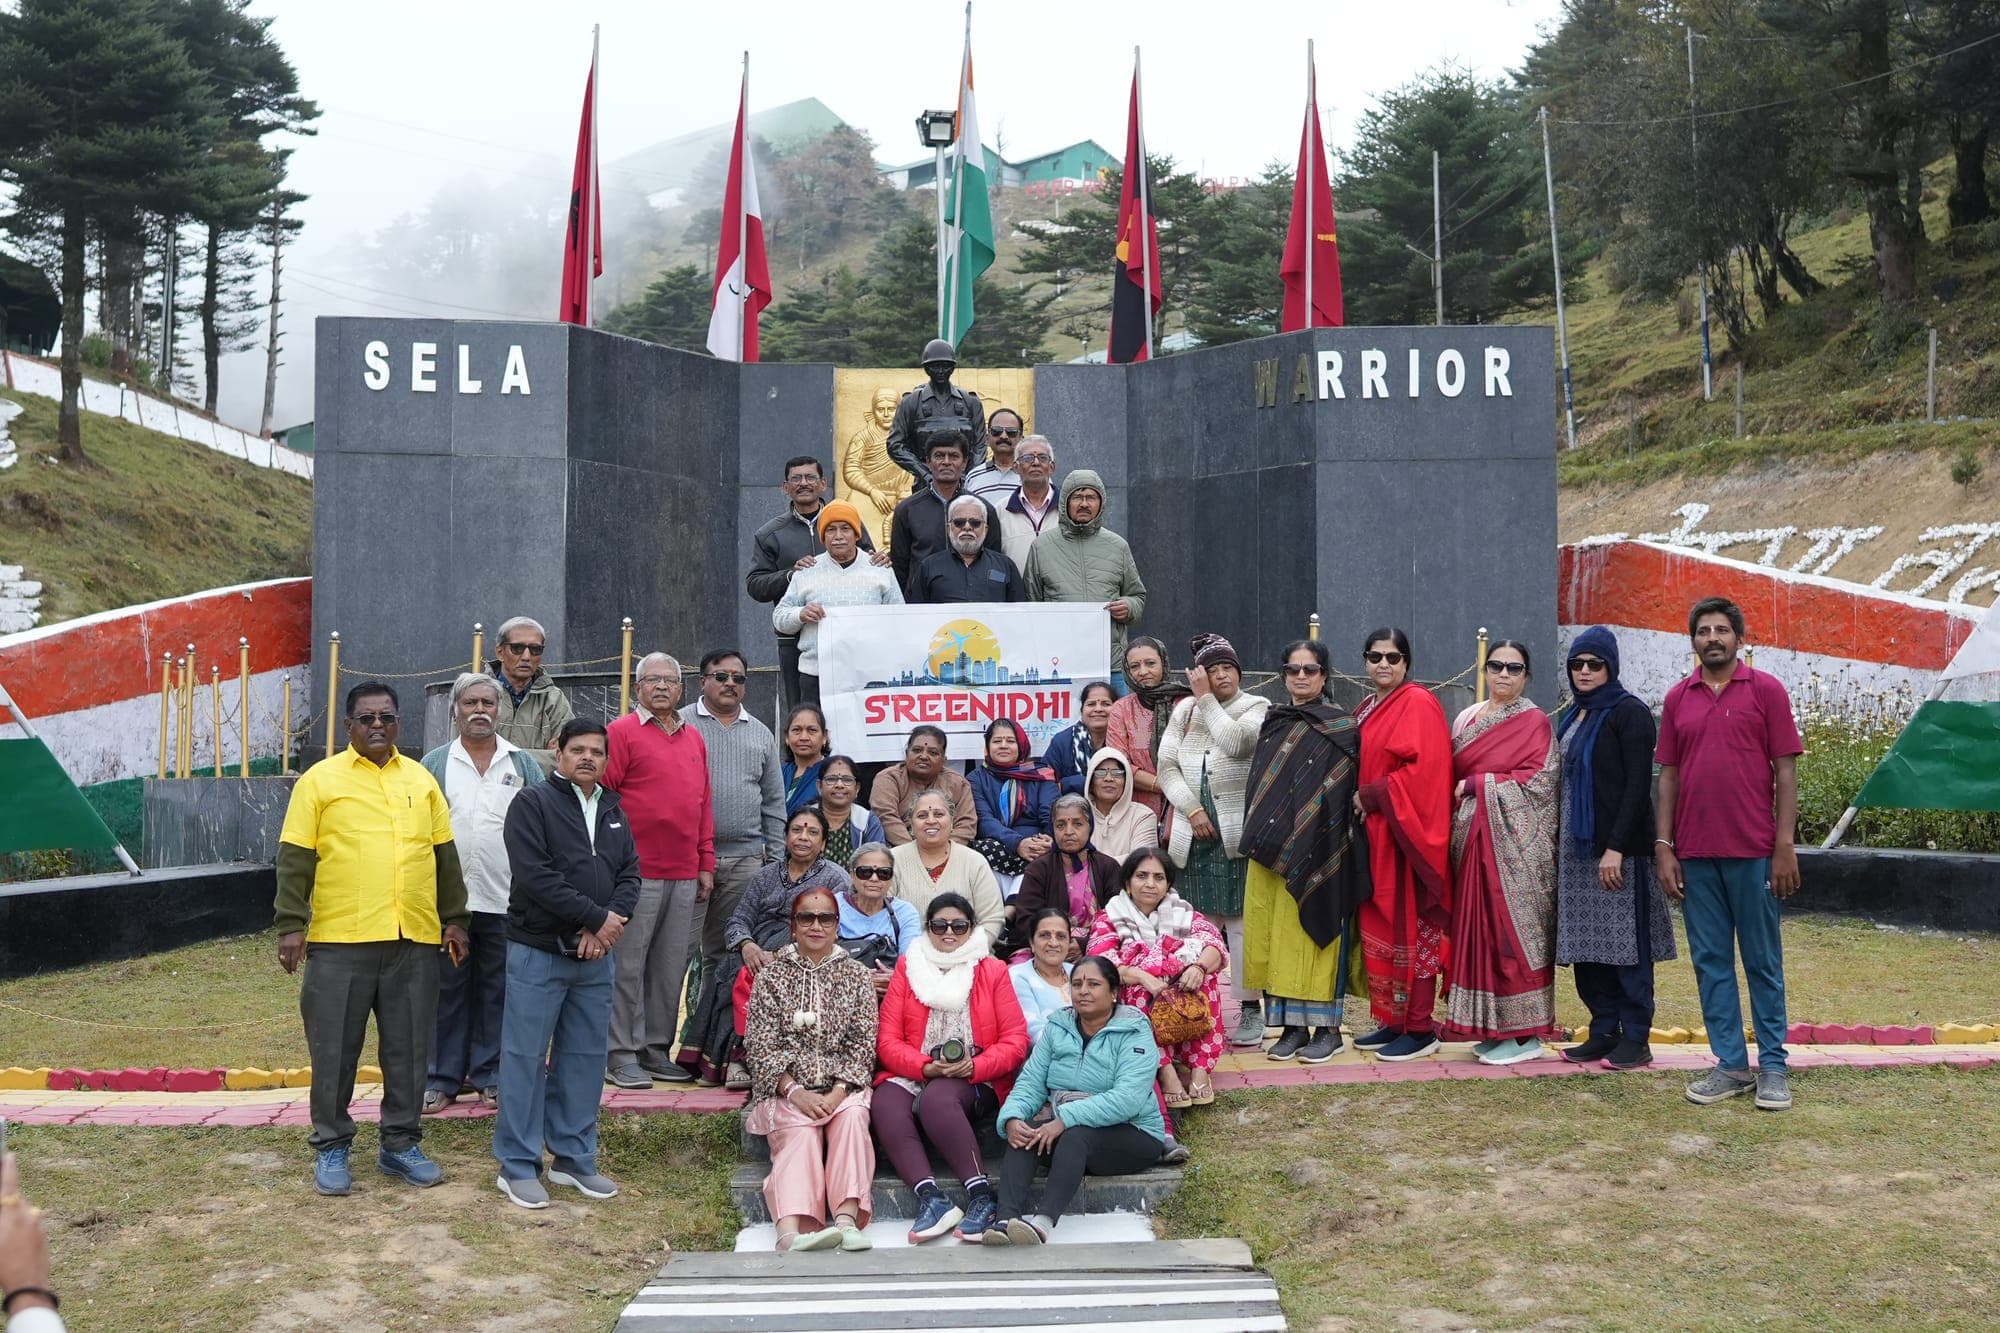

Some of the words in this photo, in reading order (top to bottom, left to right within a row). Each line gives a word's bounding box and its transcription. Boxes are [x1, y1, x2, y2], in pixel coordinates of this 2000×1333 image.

[363, 340, 532, 396] SELA
[1253, 347, 1513, 409] WARRIOR
[864, 691, 1071, 724] SREENIDHI
